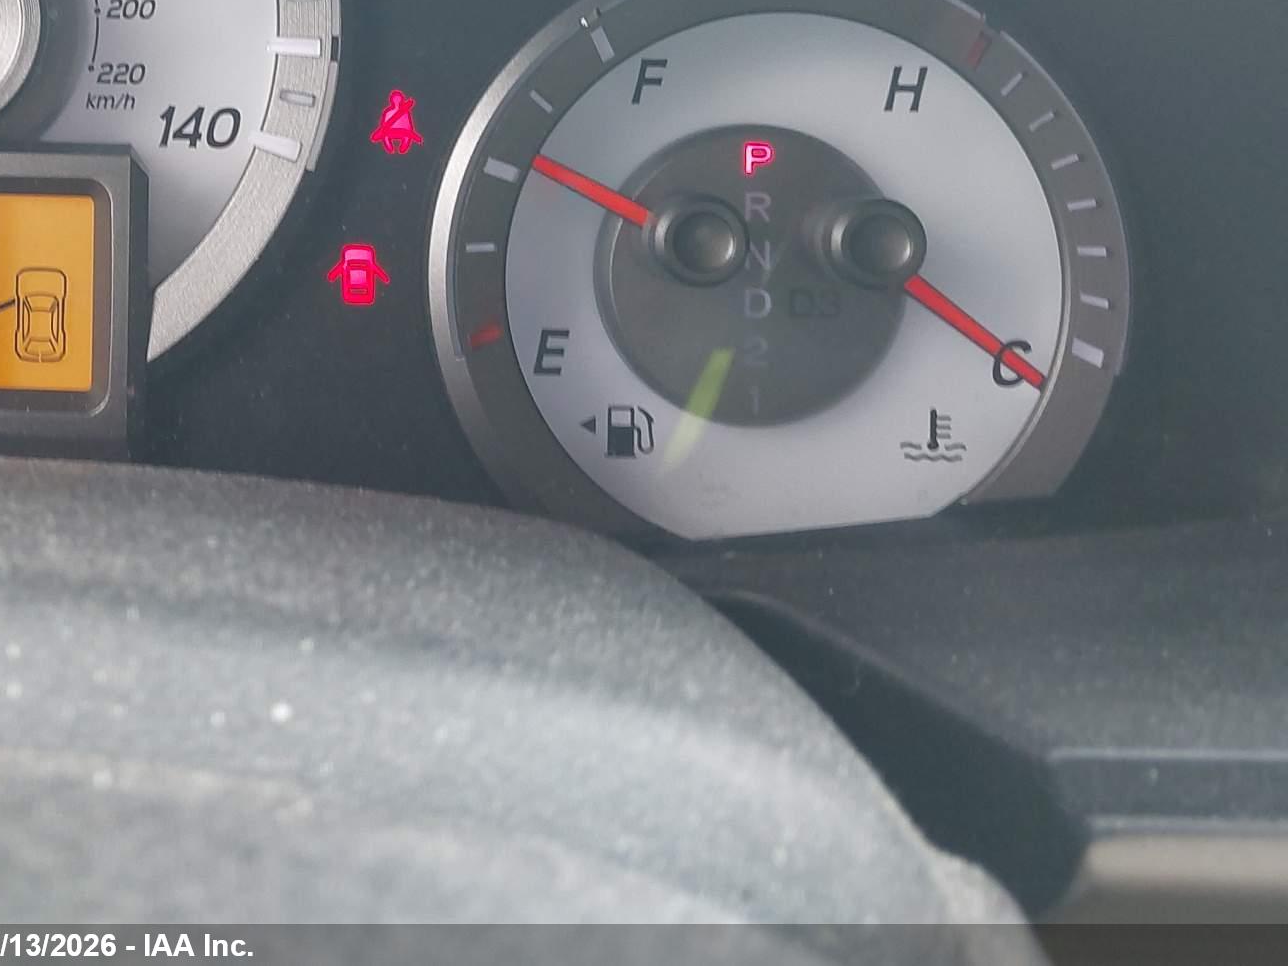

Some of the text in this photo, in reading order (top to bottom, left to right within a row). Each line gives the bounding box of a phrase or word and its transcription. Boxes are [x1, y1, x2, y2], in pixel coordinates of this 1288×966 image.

[96, 61, 146, 86] 220
[631, 58, 668, 106] F
[884, 66, 928, 112] H
[86, 90, 135, 113] km/h
[158, 106, 243, 150] 140
[743, 142, 774, 175] P
[744, 192, 772, 223] R
[744, 239, 772, 271] N
[744, 289, 772, 319] D
[533, 329, 570, 376] E
[992, 340, 1031, 388] C
